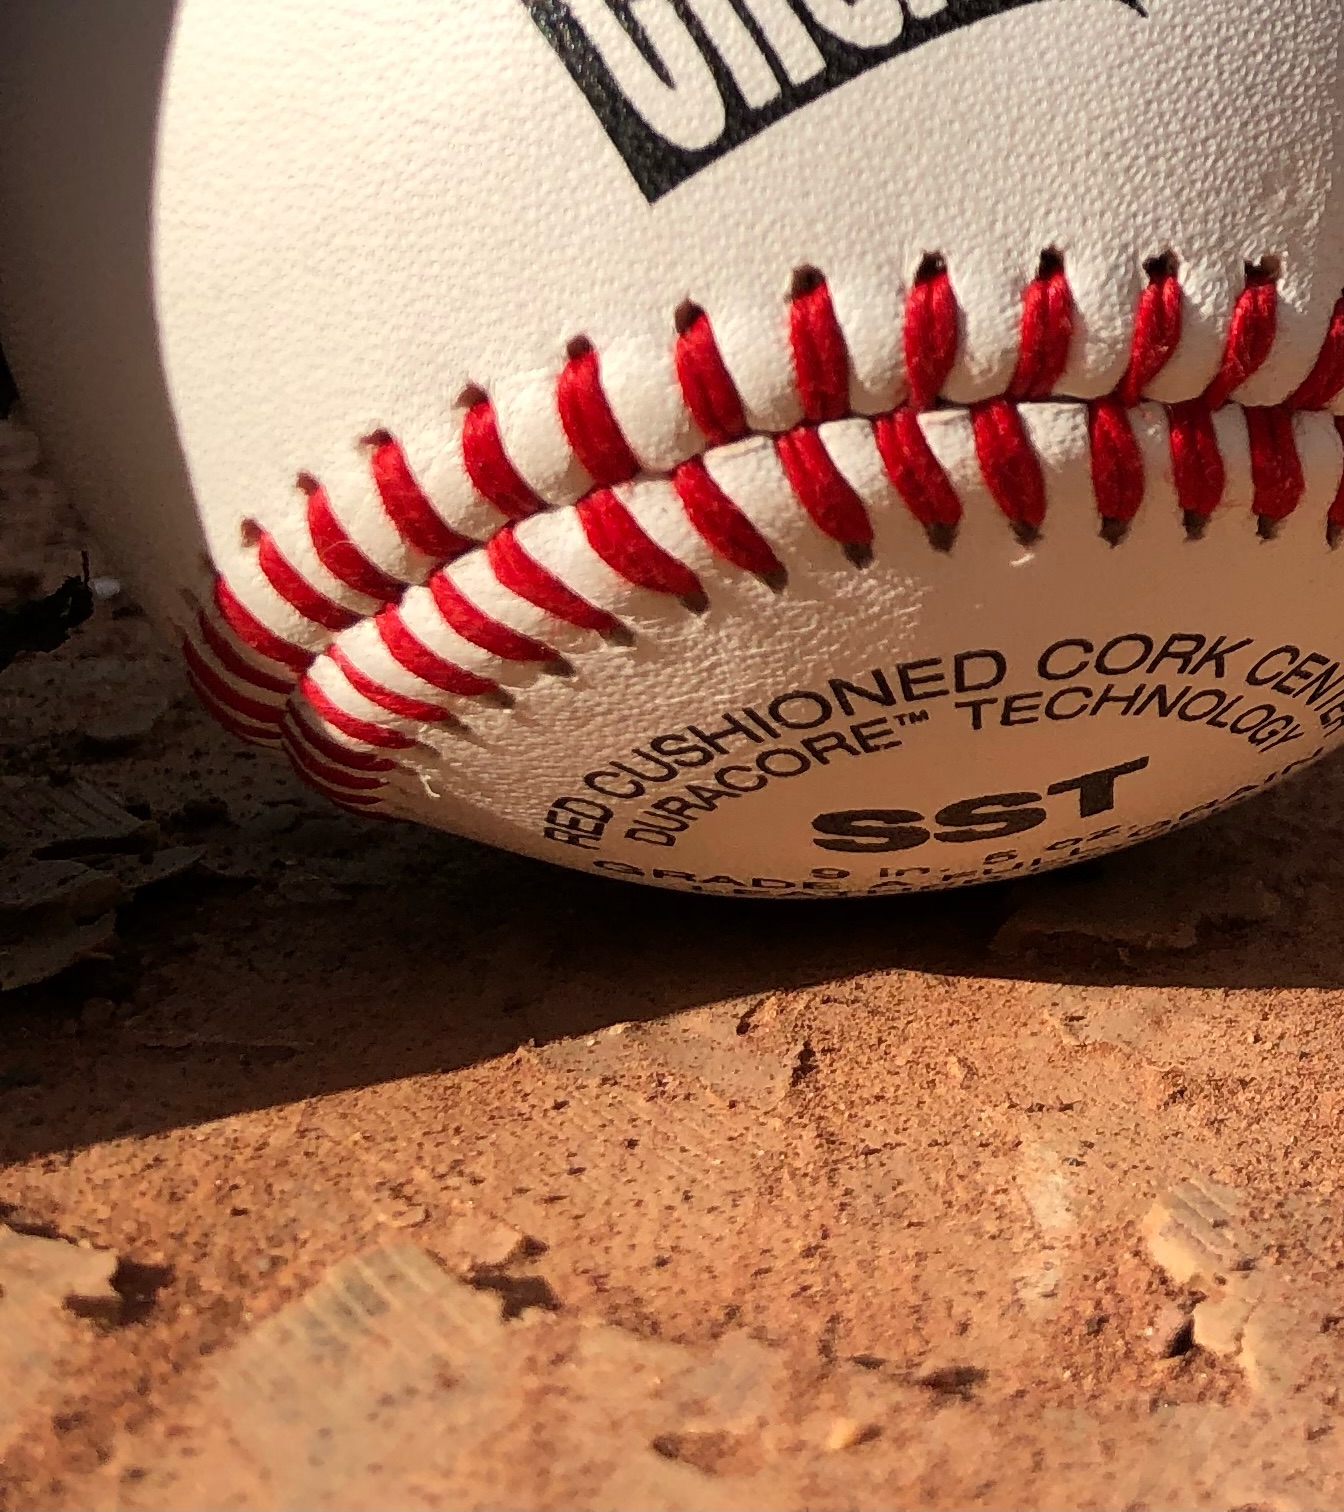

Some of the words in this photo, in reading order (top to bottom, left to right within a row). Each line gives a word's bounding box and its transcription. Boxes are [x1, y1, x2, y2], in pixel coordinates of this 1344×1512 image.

[543, 796, 614, 850] RED
[583, 648, 1007, 799] CUSHIONED
[1037, 632, 1255, 681] CORK
[954, 683, 1304, 754] TECHNOLOGY
[811, 755, 1150, 853] SST
[593, 859, 840, 890] GRADE
